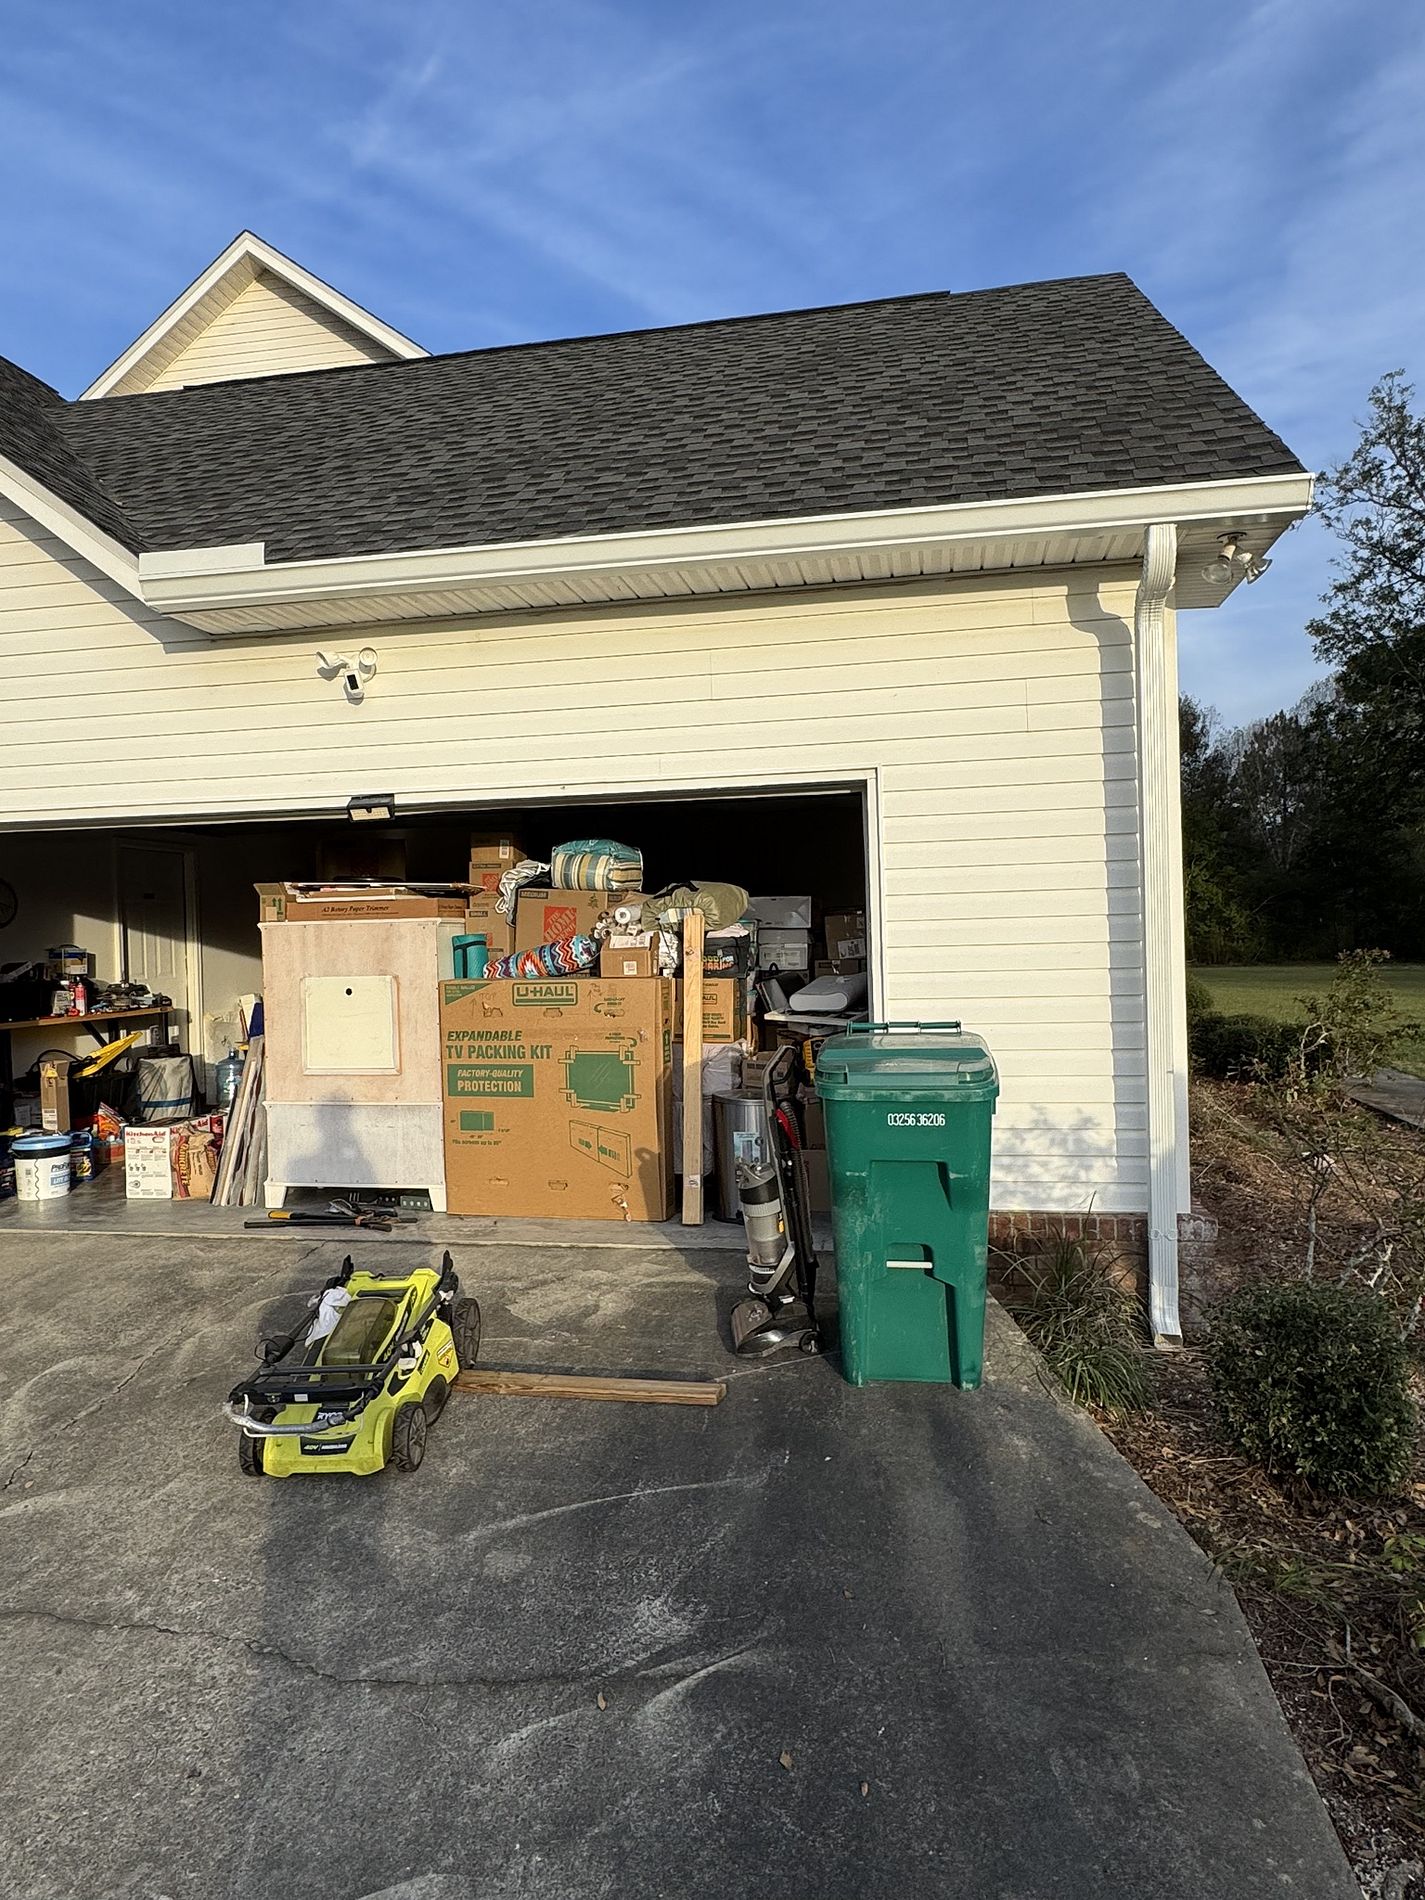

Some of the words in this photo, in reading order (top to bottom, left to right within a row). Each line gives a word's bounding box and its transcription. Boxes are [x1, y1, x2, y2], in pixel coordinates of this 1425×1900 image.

[516, 986, 574, 997] U-HAUL
[447, 1030, 523, 1041] EXPANDABLE
[446, 1044, 463, 1059] TV
[468, 1044, 526, 1059] PACKING
[530, 1044, 553, 1059] KIT
[457, 1069, 524, 1078] FACTORY-QUALITY
[457, 1080, 522, 1092] PROTECTION
[178, 1143, 189, 1186] QUIKRETE
